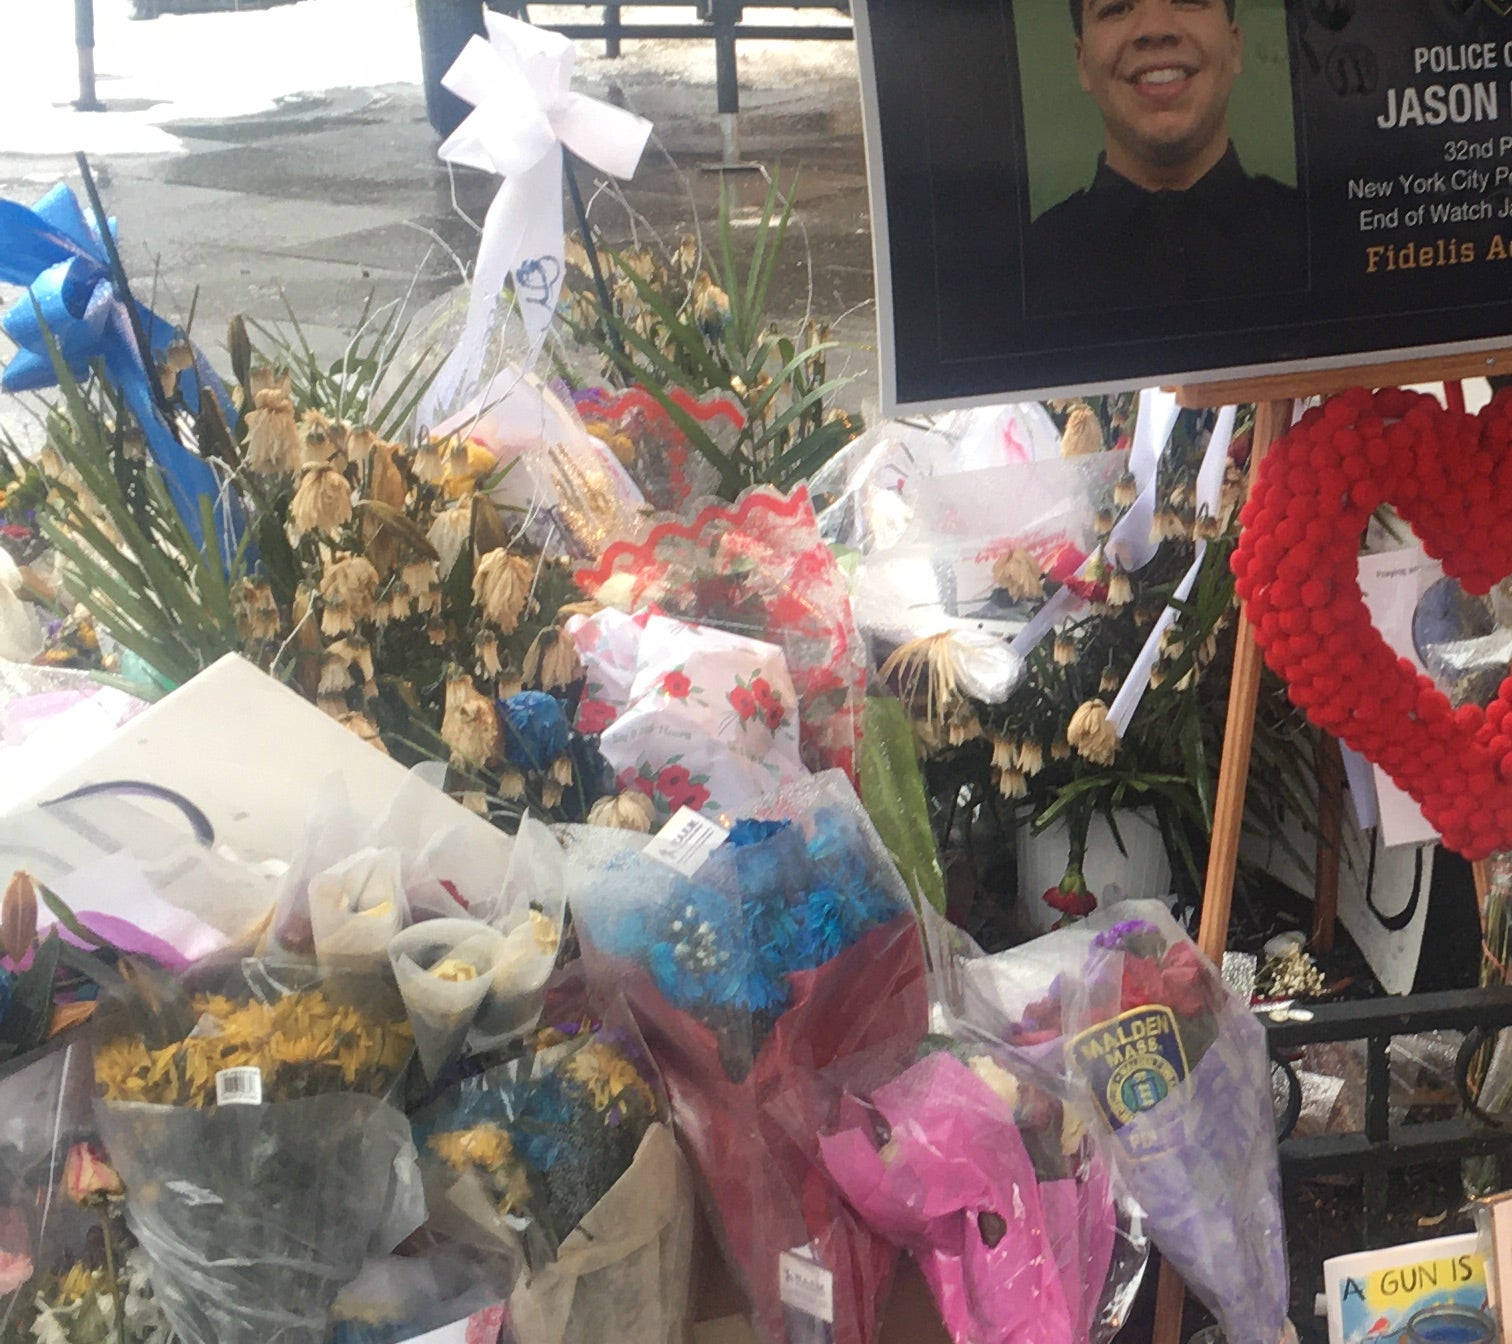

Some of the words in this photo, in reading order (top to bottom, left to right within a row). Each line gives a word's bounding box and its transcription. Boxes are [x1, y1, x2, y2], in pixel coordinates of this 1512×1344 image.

[1414, 46, 1497, 74] POLICE
[1377, 80, 1498, 130] JASON
[1443, 138, 1494, 161] 32nd
[1348, 179, 1392, 201] New
[1399, 173, 1445, 195] York
[1451, 168, 1489, 192] City
[1360, 210, 1398, 231] End
[1404, 206, 1426, 227] of
[1430, 200, 1492, 224] Watch
[1366, 238, 1475, 273] Fidelis
[1081, 1015, 1169, 1059] MALDEN
[1105, 1038, 1163, 1068] MASS.
[1343, 1277, 1366, 1301] A
[1380, 1263, 1437, 1296] GUN
[1452, 1255, 1473, 1282] IS
